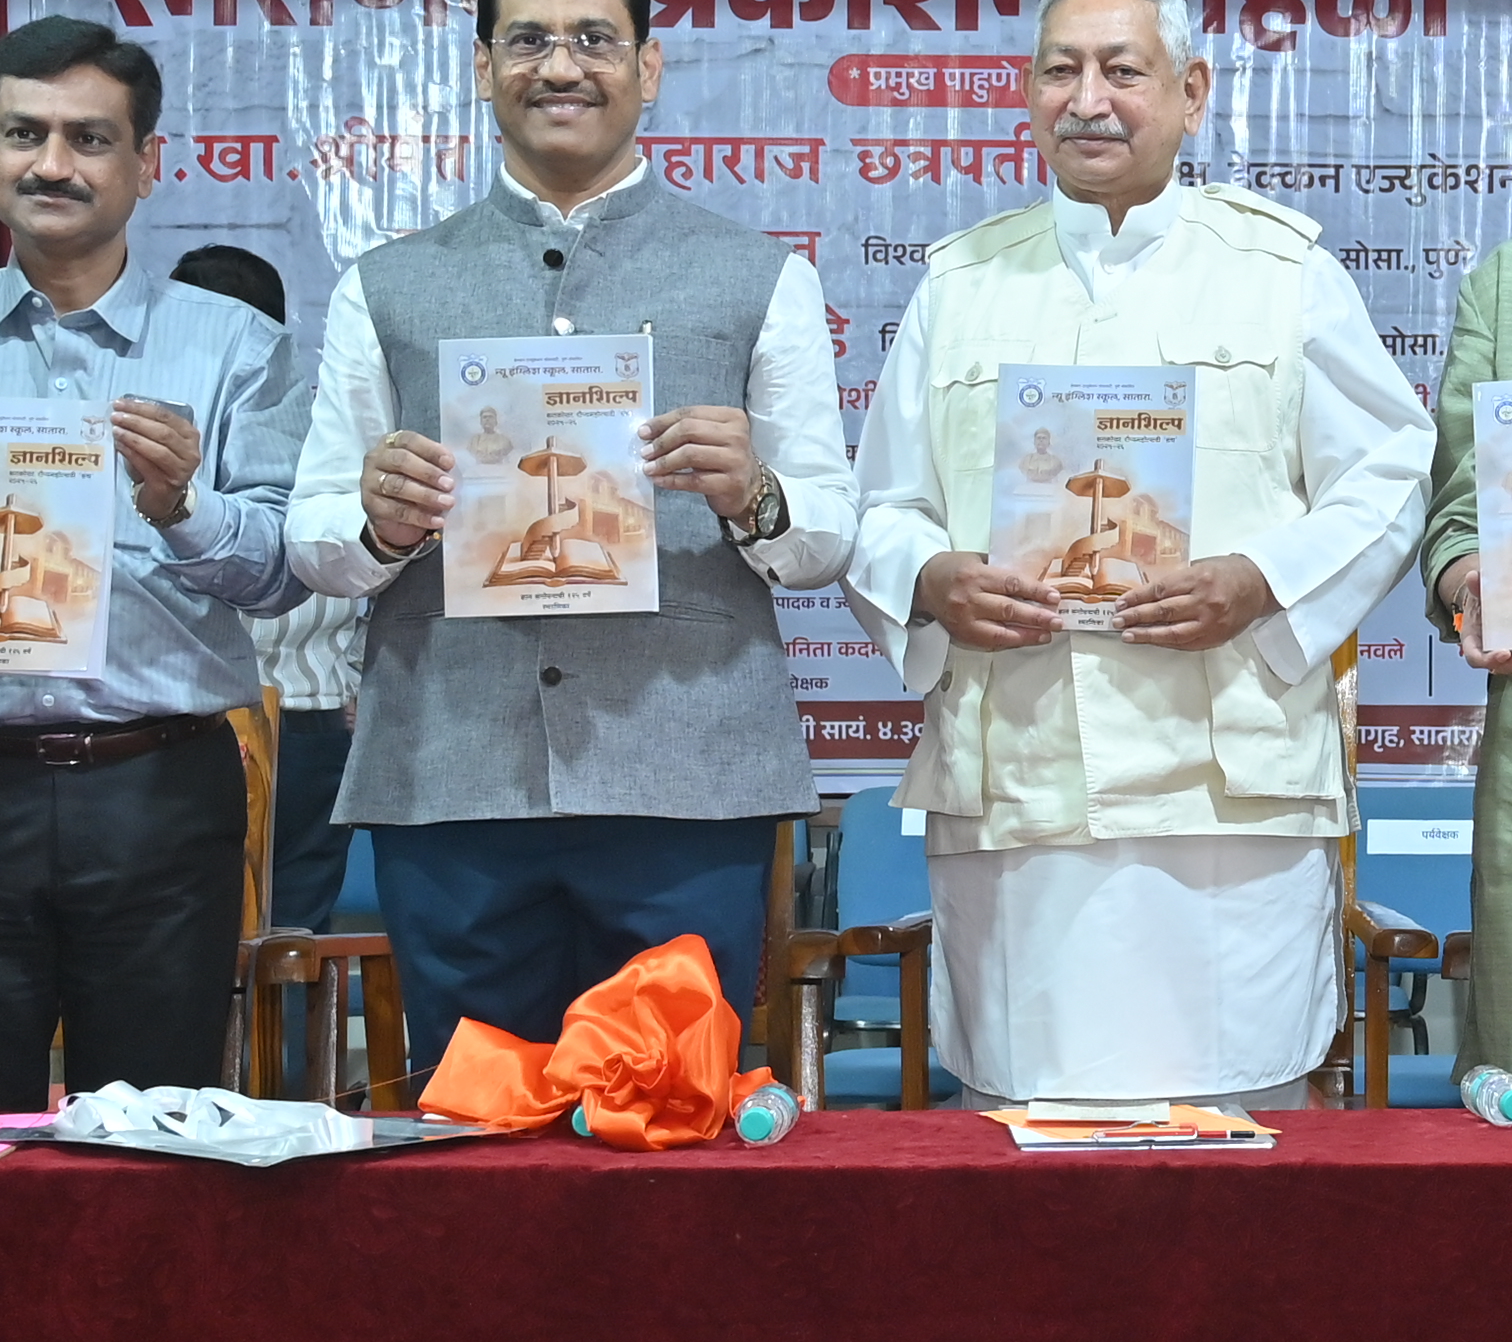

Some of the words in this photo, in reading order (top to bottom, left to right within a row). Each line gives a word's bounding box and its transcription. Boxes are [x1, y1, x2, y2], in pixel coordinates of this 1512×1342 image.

[868, 66, 936, 100] प्रमुख
[945, 62, 1018, 101] पाहुणे
[636, 136, 826, 192] हाराज
[1228, 151, 1345, 195] डेक्कन
[861, 235, 931, 266] विश्व
[1423, 240, 1472, 280] पुणे
[545, 385, 638, 406] ज्ञानशिल्प
[1097, 412, 1184, 432] ज्ञानशिल्प
[9, 446, 101, 467] ज्ञानशिल्प
[773, 595, 816, 611] पादक
[785, 636, 833, 658] निता
[1358, 638, 1406, 660] नवले
[789, 673, 830, 691] वेक्षक
[820, 715, 872, 741] सायं.
[1357, 725, 1405, 753] ागृह,
[1421, 827, 1460, 841] पर्यवेक्षक
